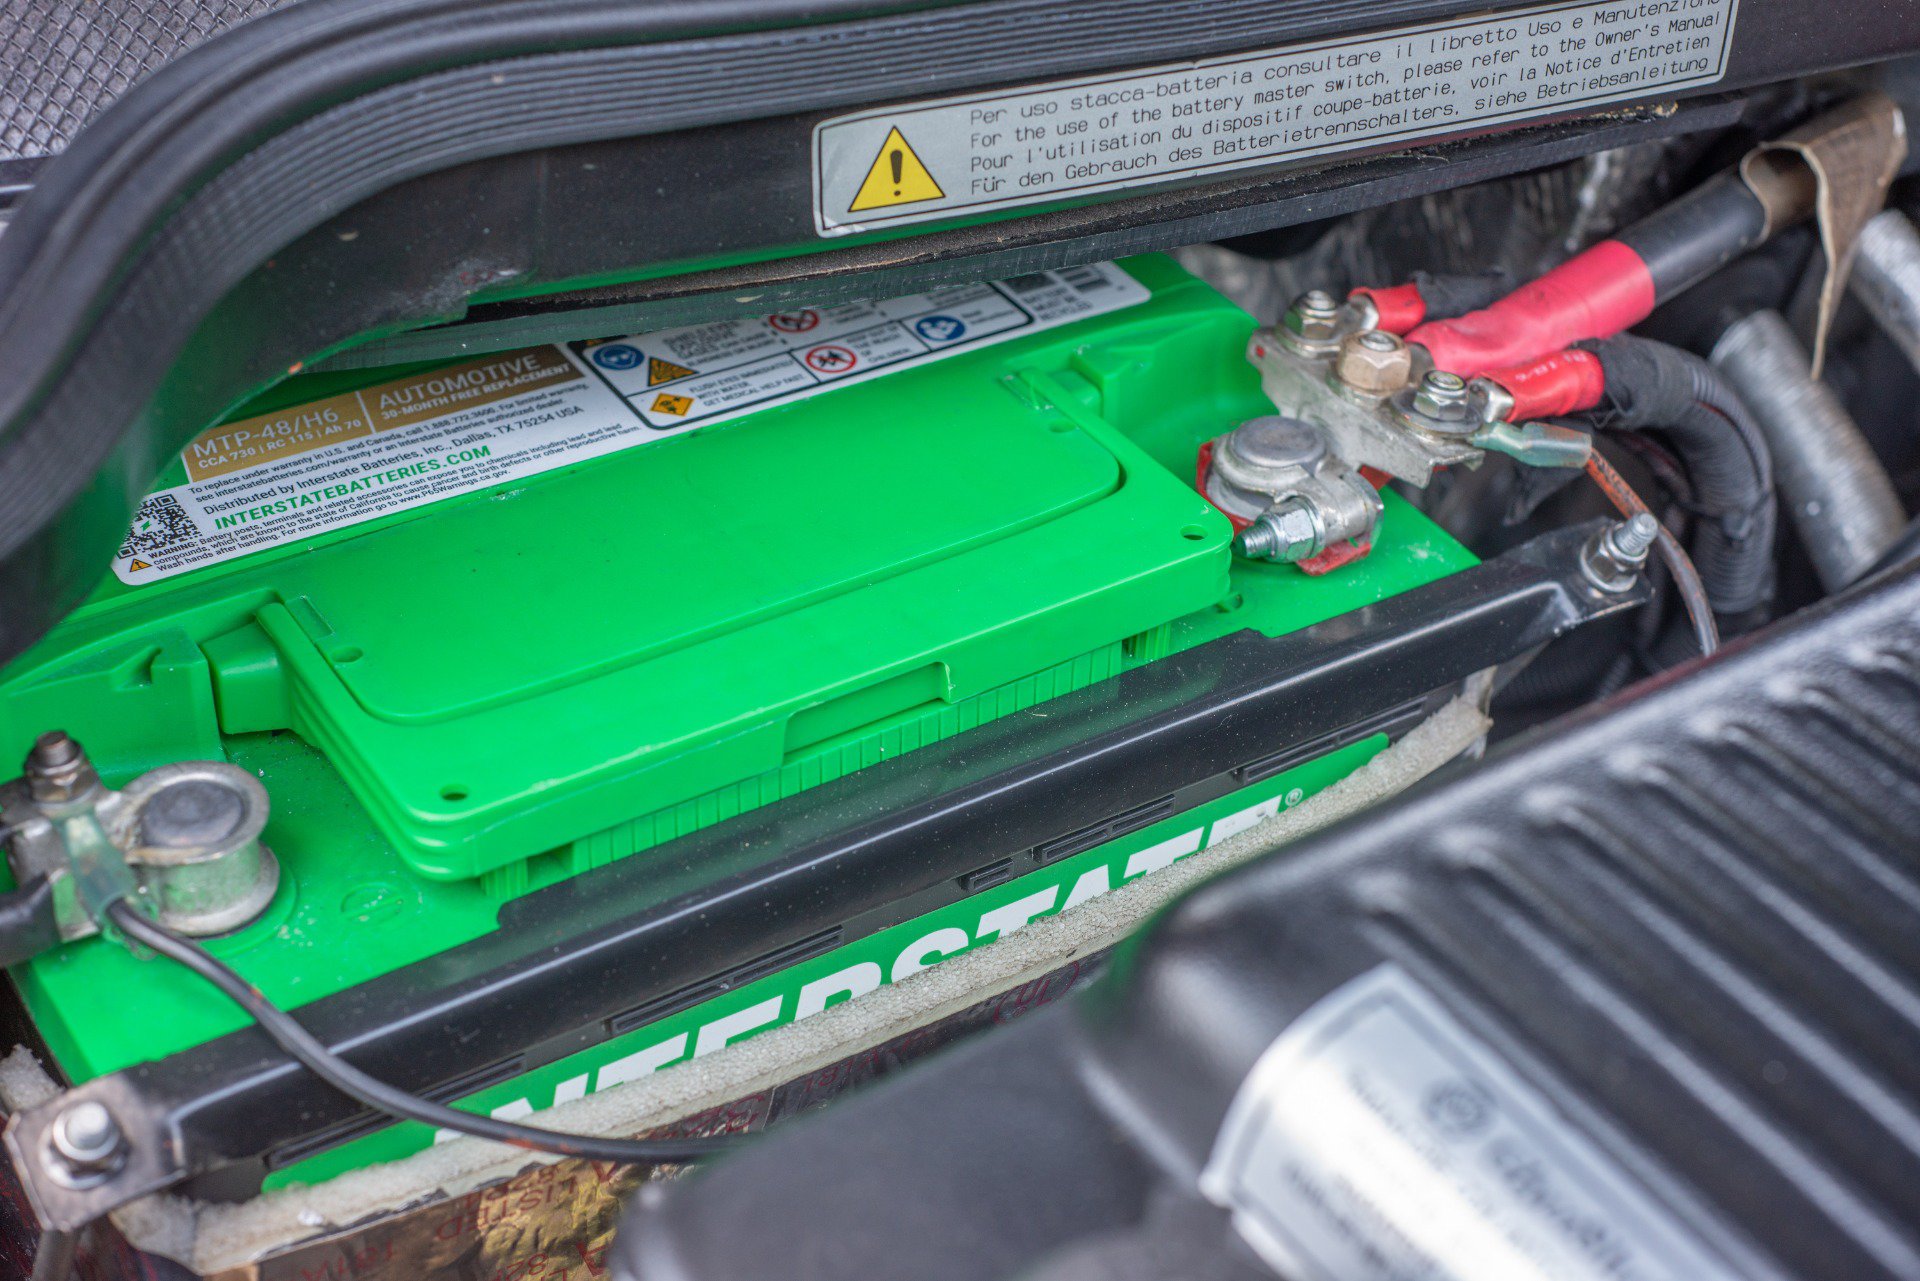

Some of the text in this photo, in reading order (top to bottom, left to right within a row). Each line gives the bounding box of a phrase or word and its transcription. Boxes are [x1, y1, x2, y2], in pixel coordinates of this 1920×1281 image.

[970, 108, 1008, 125] Per
[1020, 101, 1059, 119] uso
[1070, 70, 1253, 111] stacca-batteria
[1263, 50, 1382, 81] consultare
[1397, 42, 1412, 59] il
[1430, 27, 1518, 54] libretto
[1527, 20, 1562, 37] Uso
[1572, 16, 1584, 30] e
[970, 11, 1720, 149] For the use of the battery master switch, please refer to the Owner's Manual
[970, 35, 1711, 173] Pour l'utilisation du dispositif coupe-batterie, voir la Notice d'Entretien
[971, 57, 1709, 195] Für den Gebrauch des Batterietrennschalters, siehe Betriebsanleitung
[192, 409, 339, 459] MTP-48/H6
[379, 357, 540, 412] AUTOMOTIVE
[381, 363, 569, 420] 30-MONTH FREE REPLACEMENT
[195, 493, 215, 503] see
[214, 450, 372, 498] interstatebatteries.com/warranty
[396, 432, 444, 448] Interstate
[442, 420, 487, 436] Batteries
[487, 405, 536, 424] authorized
[198, 455, 229, 469] CCA
[229, 446, 257, 461] 730
[266, 439, 286, 451] RC
[288, 431, 314, 444] 115
[324, 424, 343, 436] Ah
[344, 419, 362, 430] 70
[202, 405, 584, 515] Distributed by Interstate Batteries, Inc., Dallas, TX 75254 USA
[203, 476, 241, 491] replace
[241, 468, 270, 480] under
[270, 456, 313, 472] warranty
[323, 447, 346, 457] U.S.
[346, 441, 366, 452] and
[365, 433, 406, 446] Canada,
[405, 426, 424, 436] call
[498, 402, 515, 411] For
[514, 392, 548, 406] limited
[548, 383, 590, 397] warranty,
[214, 445, 491, 530] INTERSTATEBATTERIES.COM
[147, 541, 196, 559] WARNING:
[199, 532, 233, 545] Battery
[233, 524, 263, 537] posts,
[262, 511, 305, 527] terminals
[305, 505, 324, 515] and
[323, 496, 356, 510] related
[355, 483, 409, 501] accessories
[408, 478, 427, 486] can
[426, 469, 458, 481] expose
[458, 465, 475, 474] you
[485, 450, 530, 465] chemicals
[529, 439, 569, 453] including
[567, 432, 587, 443] lead
[587, 428, 604, 437] and
[603, 423, 623, 432] lead
[153, 546, 211, 566] compounds,
[210, 537, 239, 549] which
[239, 533, 256, 541] are
[255, 524, 286, 540] known
[296, 516, 313, 525] the
[313, 510, 338, 520] state
[348, 494, 392, 510] California
[403, 484, 430, 495] cause
[430, 475, 460, 490] cancer
[461, 470, 479, 479] and
[477, 465, 500, 474] birth
[499, 456, 533, 469] defects
[543, 447, 565, 456] other
[564, 432, 617, 450] reproductive
[156, 560, 185, 572] Wash
[185, 552, 214, 564] hands
[215, 545, 237, 556] after
[237, 534, 279, 549] handling.
[280, 528, 297, 537] For
[297, 521, 322, 532] more
[321, 507, 374, 525] information
[436, 1174, 579, 1241] LISTED
